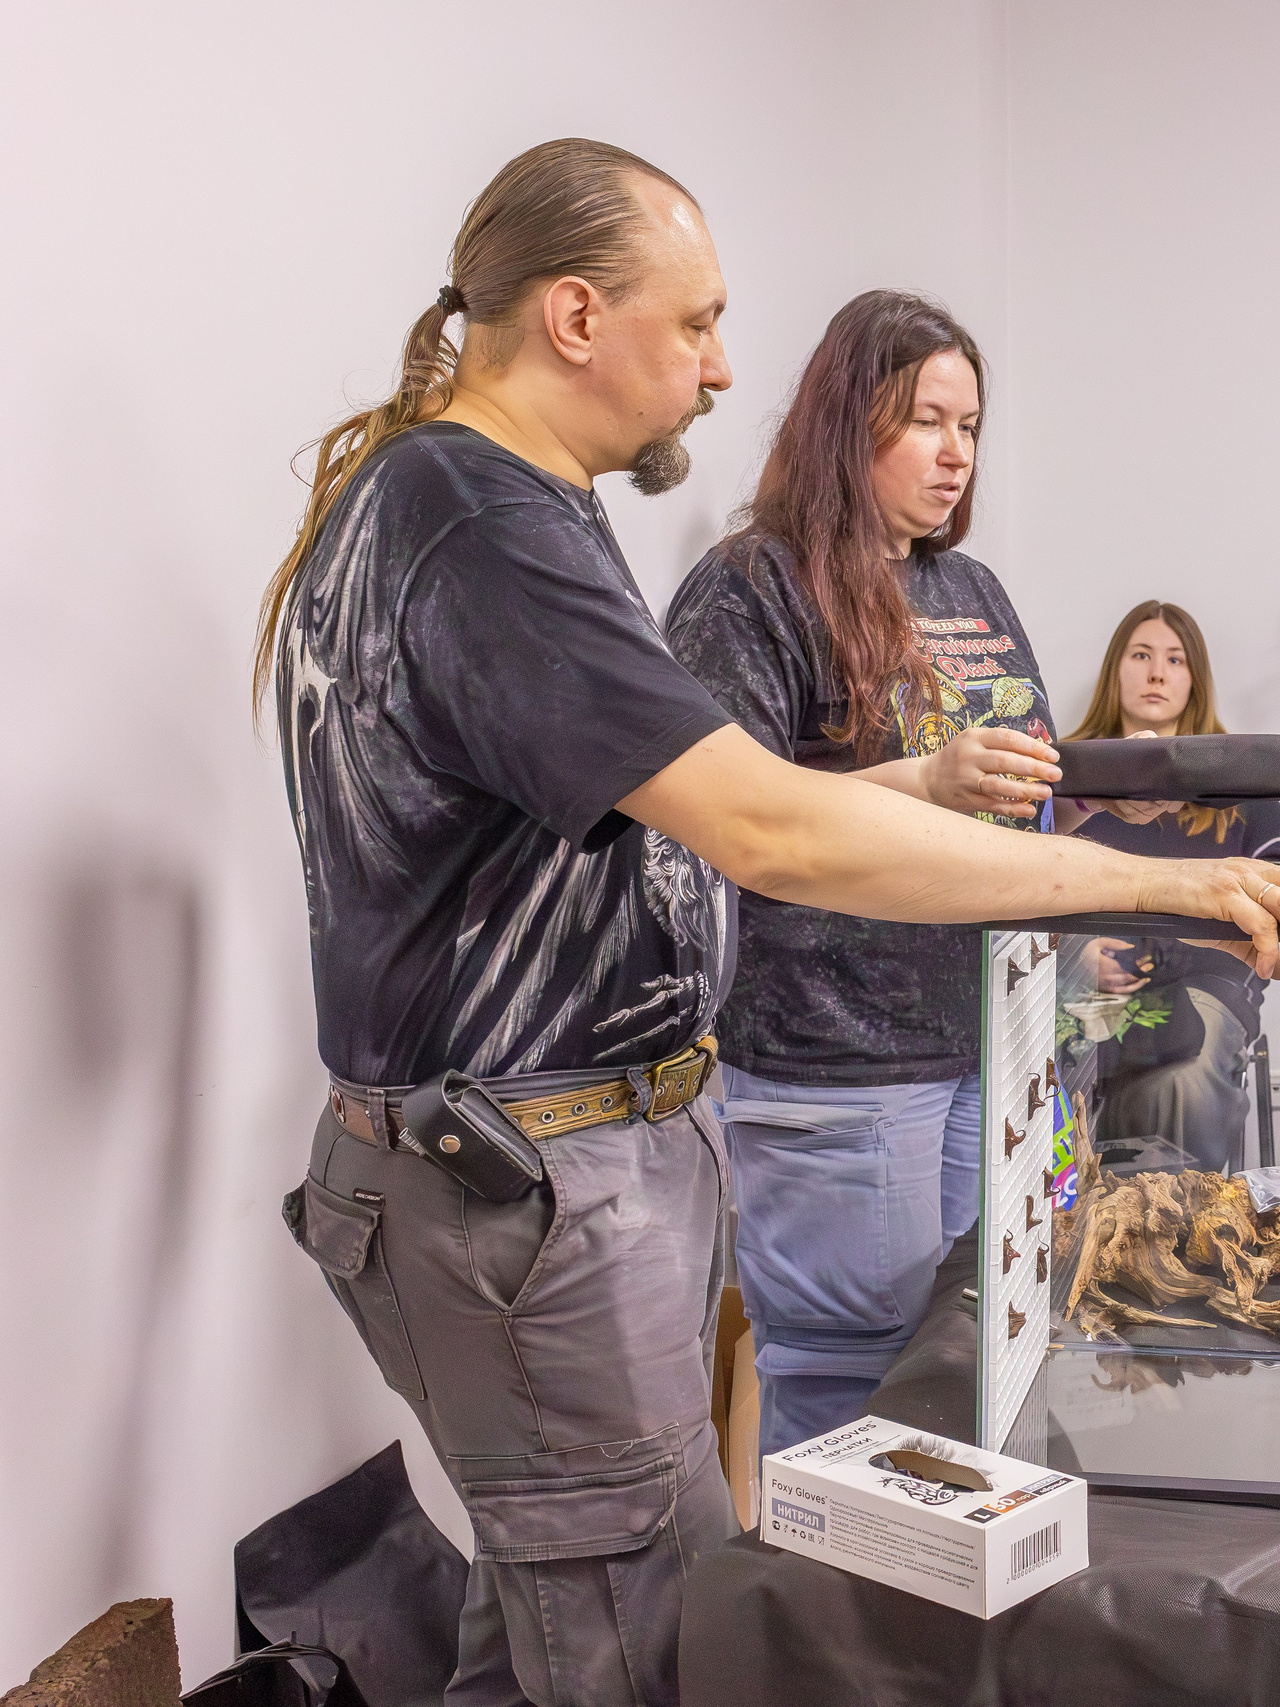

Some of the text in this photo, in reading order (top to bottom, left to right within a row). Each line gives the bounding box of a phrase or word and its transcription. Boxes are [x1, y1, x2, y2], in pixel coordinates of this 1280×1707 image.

[930, 622, 956, 632] FEED
[911, 634, 1017, 664] Carnivorous
[936, 655, 1007, 692] Plant
[781, 1444, 824, 1462] Foxy
[823, 1422, 877, 1446] Gloves
[821, 1437, 873, 1460] ПЕРЧАТКИ
[771, 1478, 826, 1505] Foxy Gloves
[777, 1503, 819, 1529] НИТРИЛ
